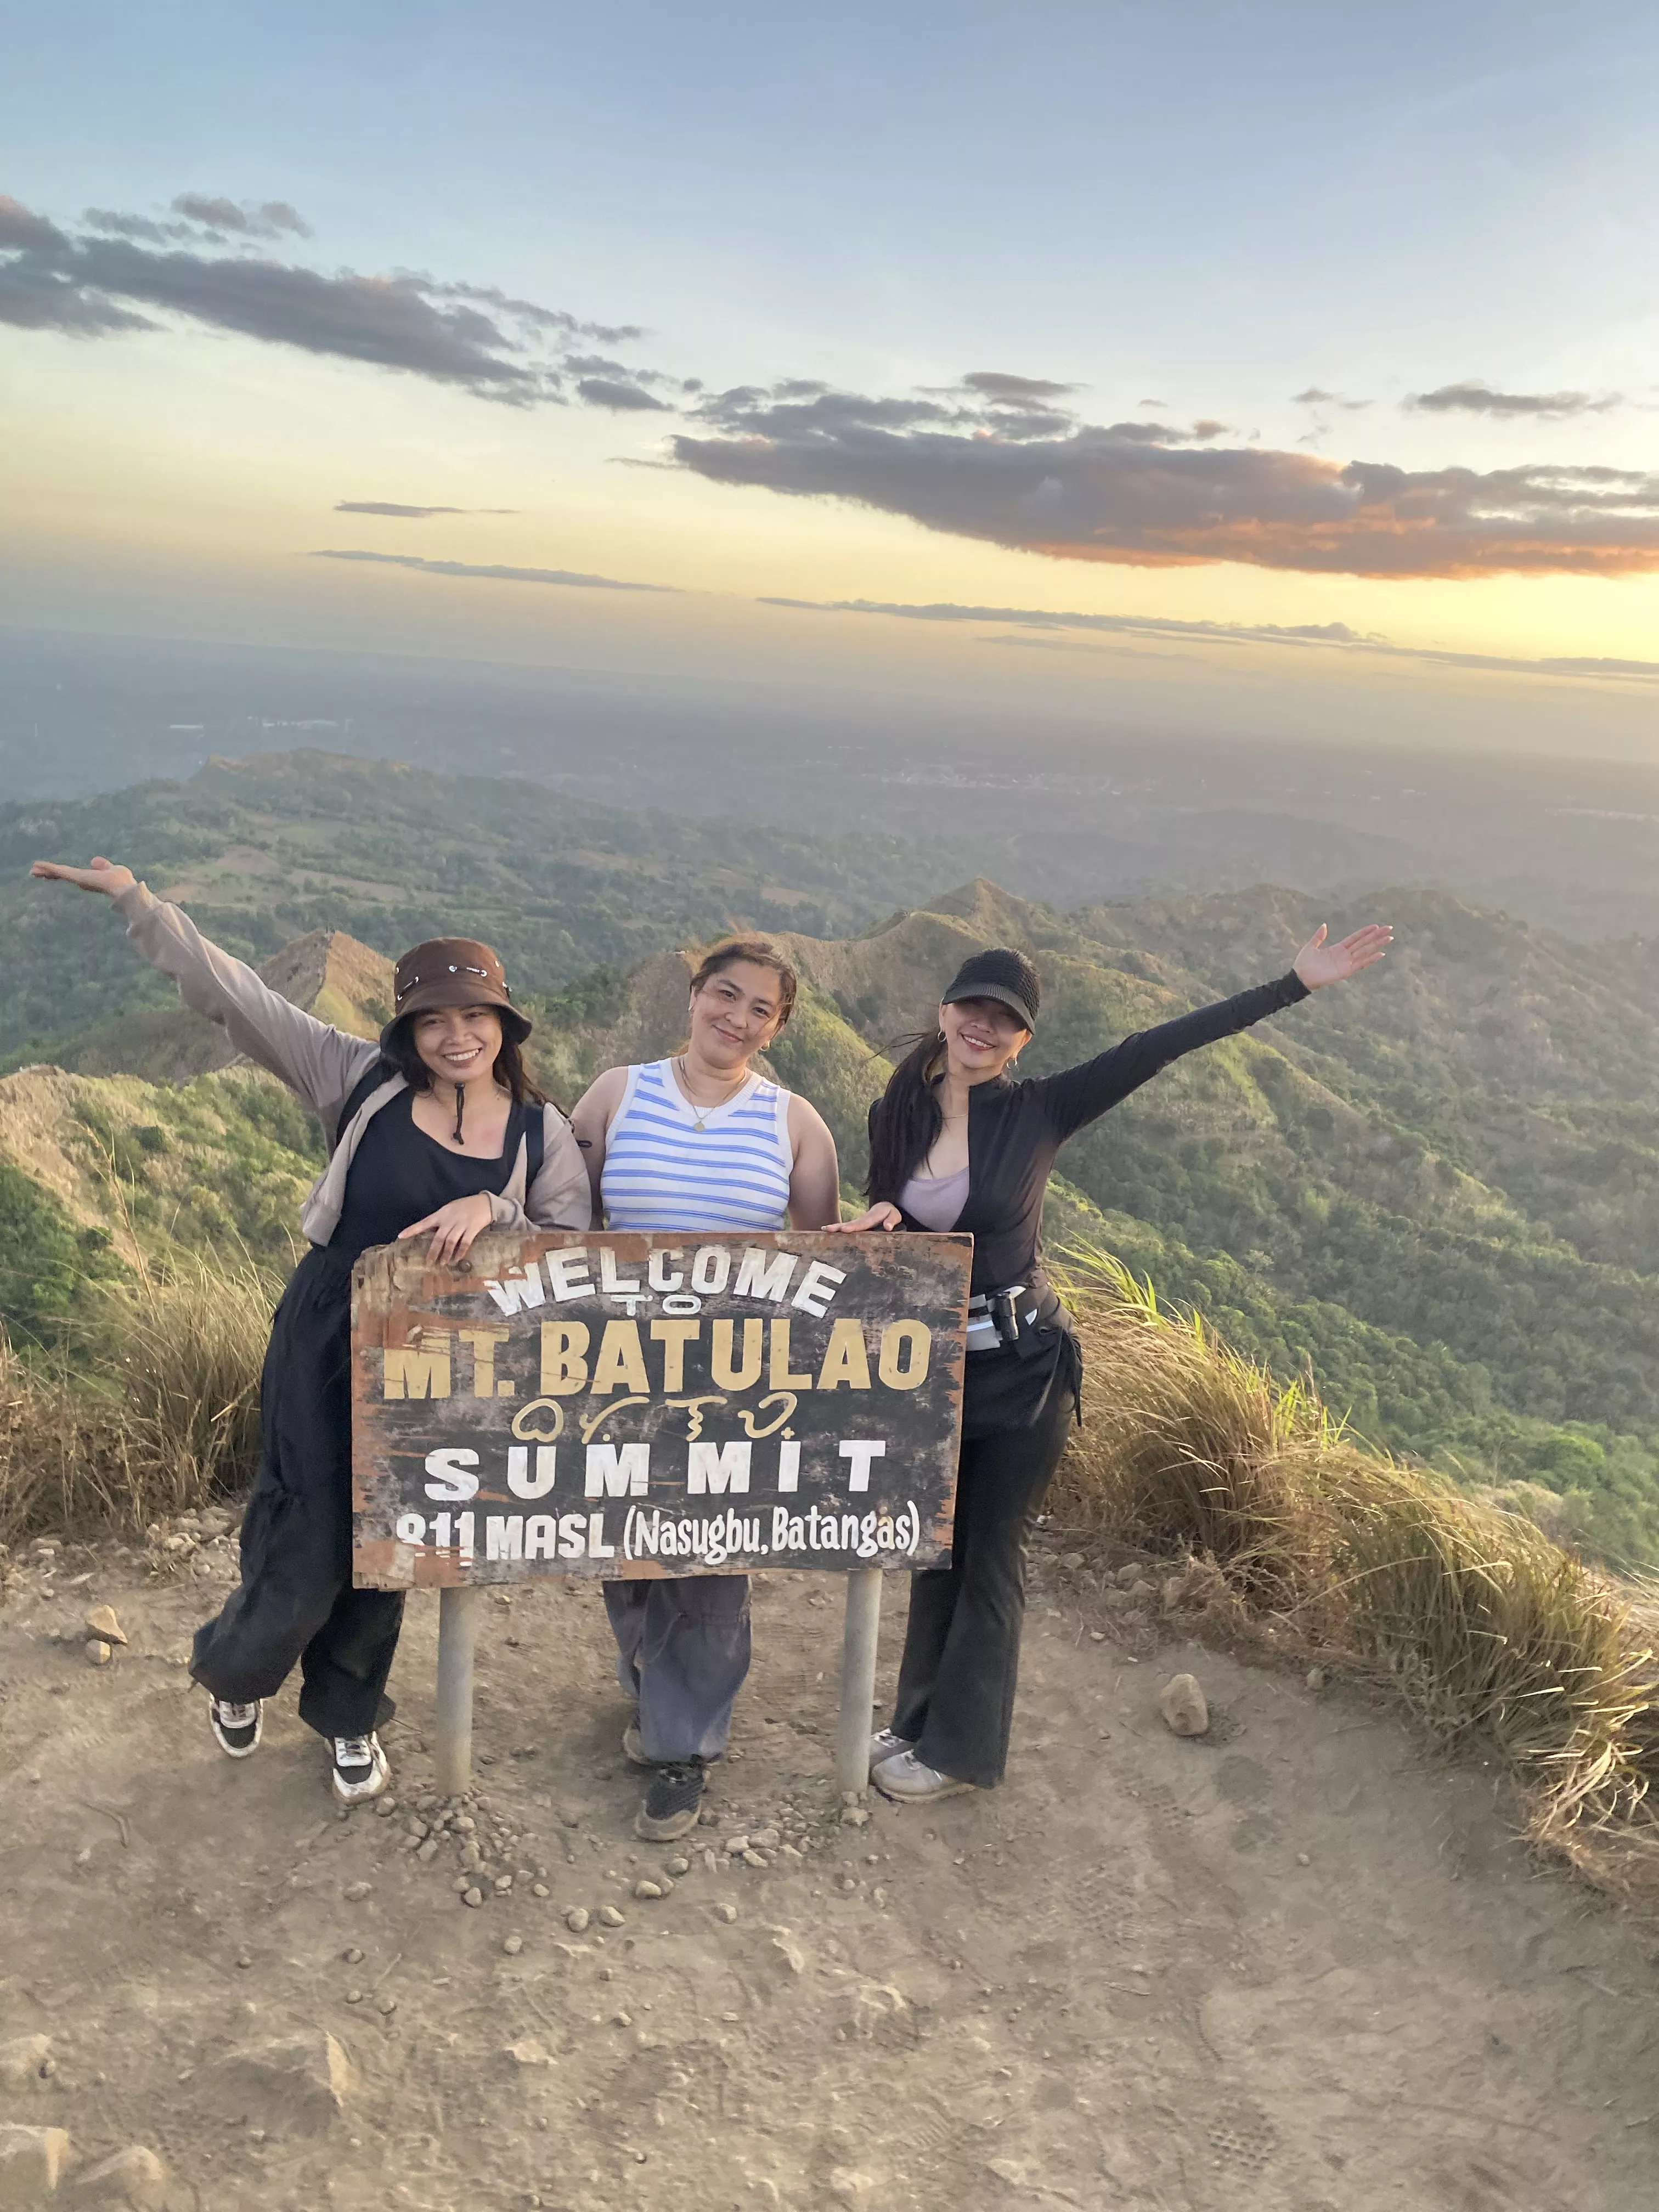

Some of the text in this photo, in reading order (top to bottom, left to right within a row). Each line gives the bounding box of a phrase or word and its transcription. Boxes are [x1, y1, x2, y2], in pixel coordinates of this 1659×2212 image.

[483, 1246, 847, 1318] WELCOME
[610, 1294, 702, 1317] TO
[383, 1318, 932, 1400] MT. BATULAO
[424, 1440, 886, 1502] SUMMIT
[486, 1513, 615, 1560] MASL
